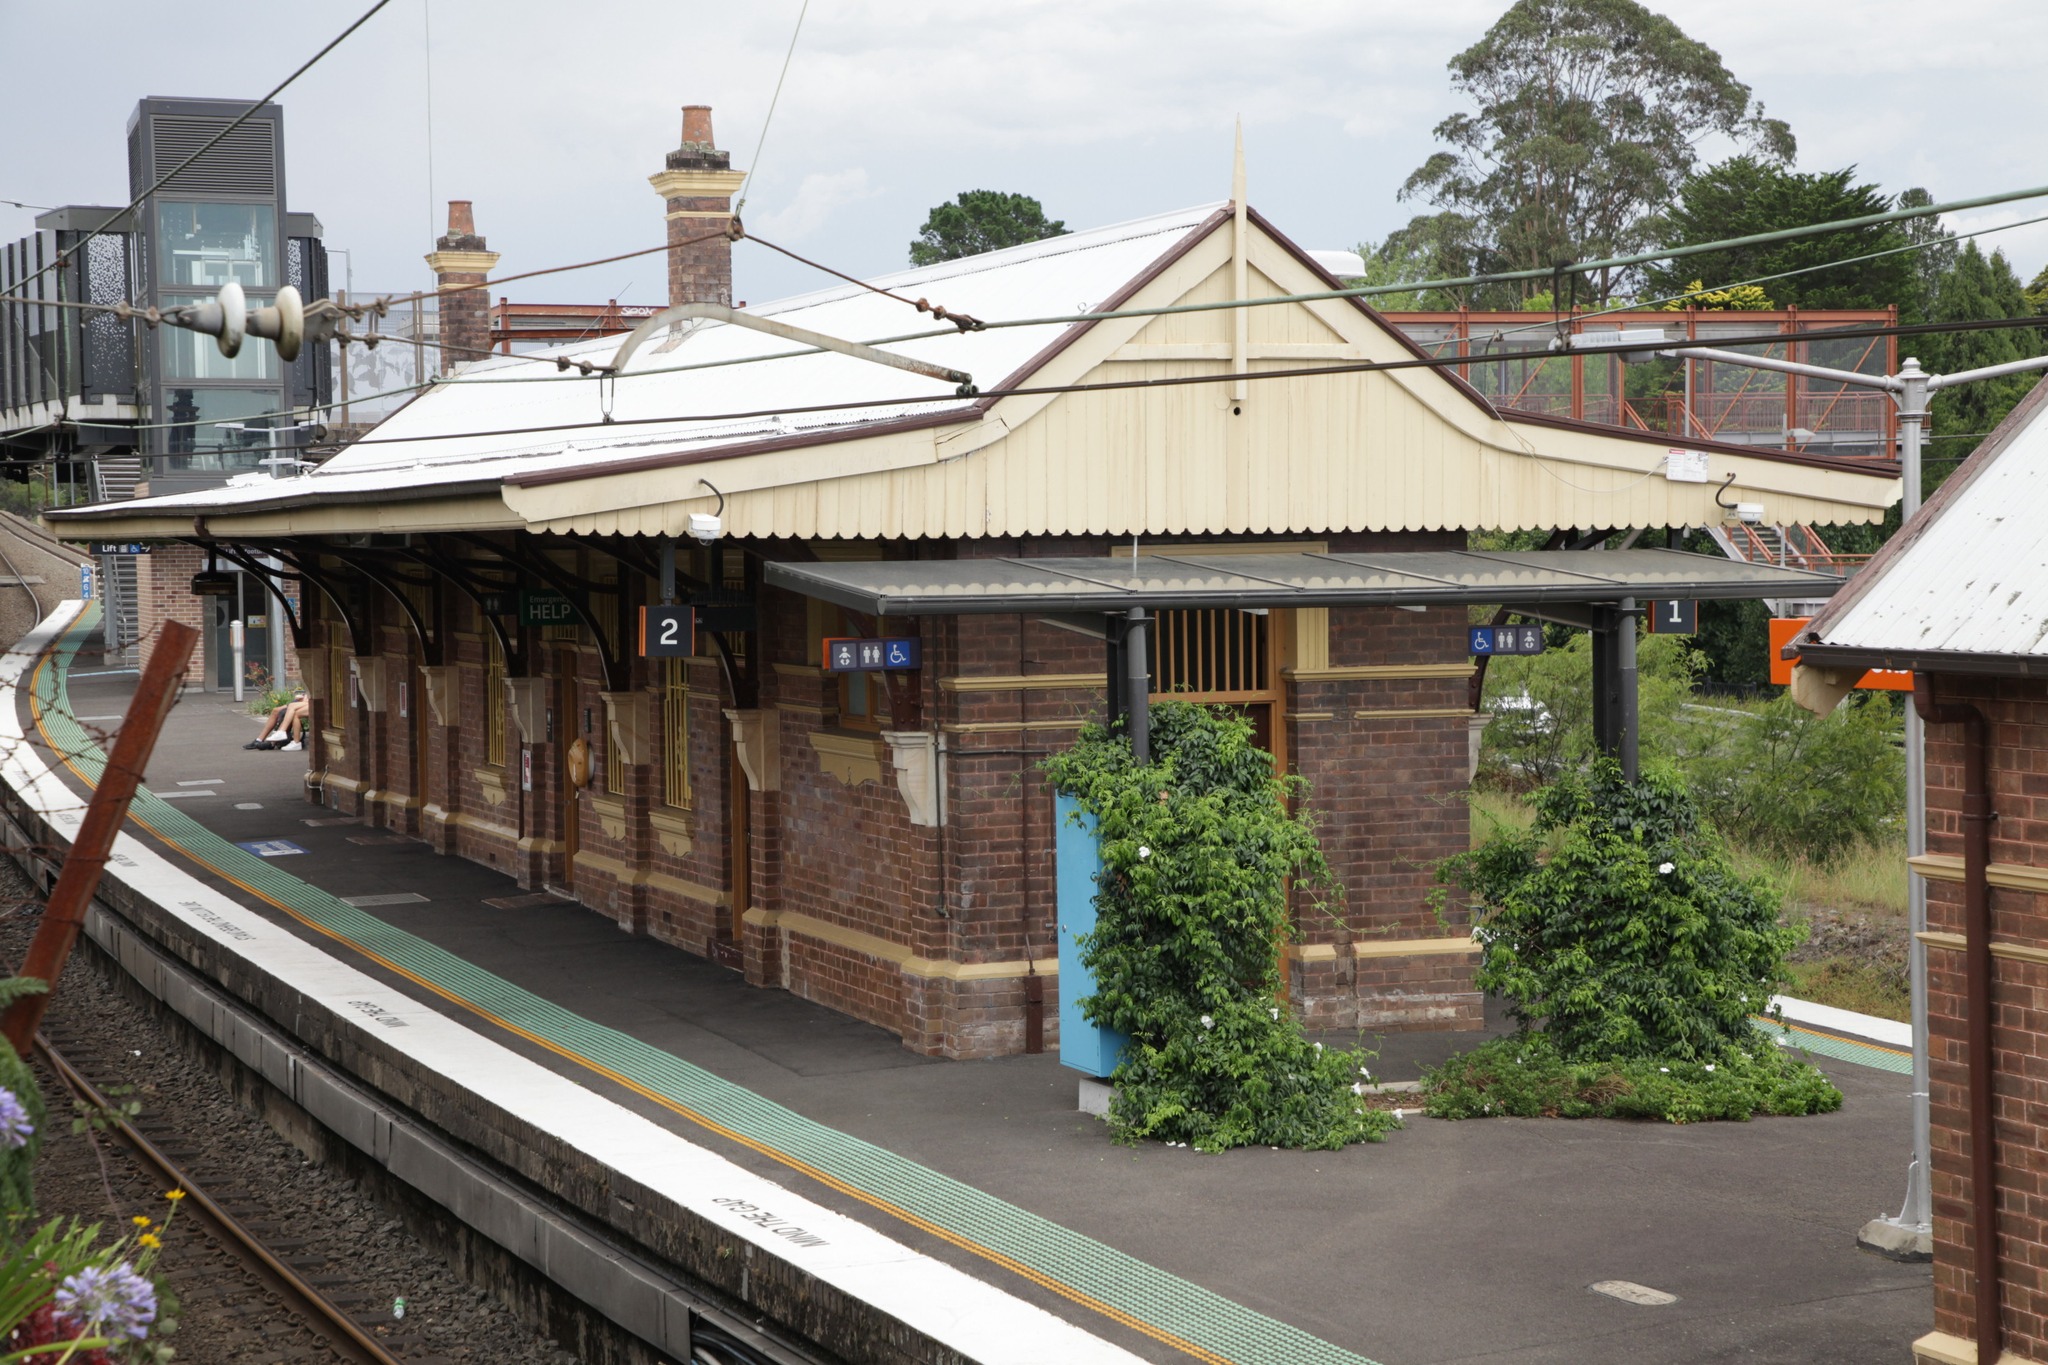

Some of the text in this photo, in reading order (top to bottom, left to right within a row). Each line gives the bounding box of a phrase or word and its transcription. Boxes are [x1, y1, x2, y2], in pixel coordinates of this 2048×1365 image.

[102, 544, 117, 553] Lift
[529, 604, 571, 619] HELP
[1668, 600, 1682, 623] 1
[660, 618, 678, 645] 2
[712, 1197, 830, 1247] MIND THE GAP
